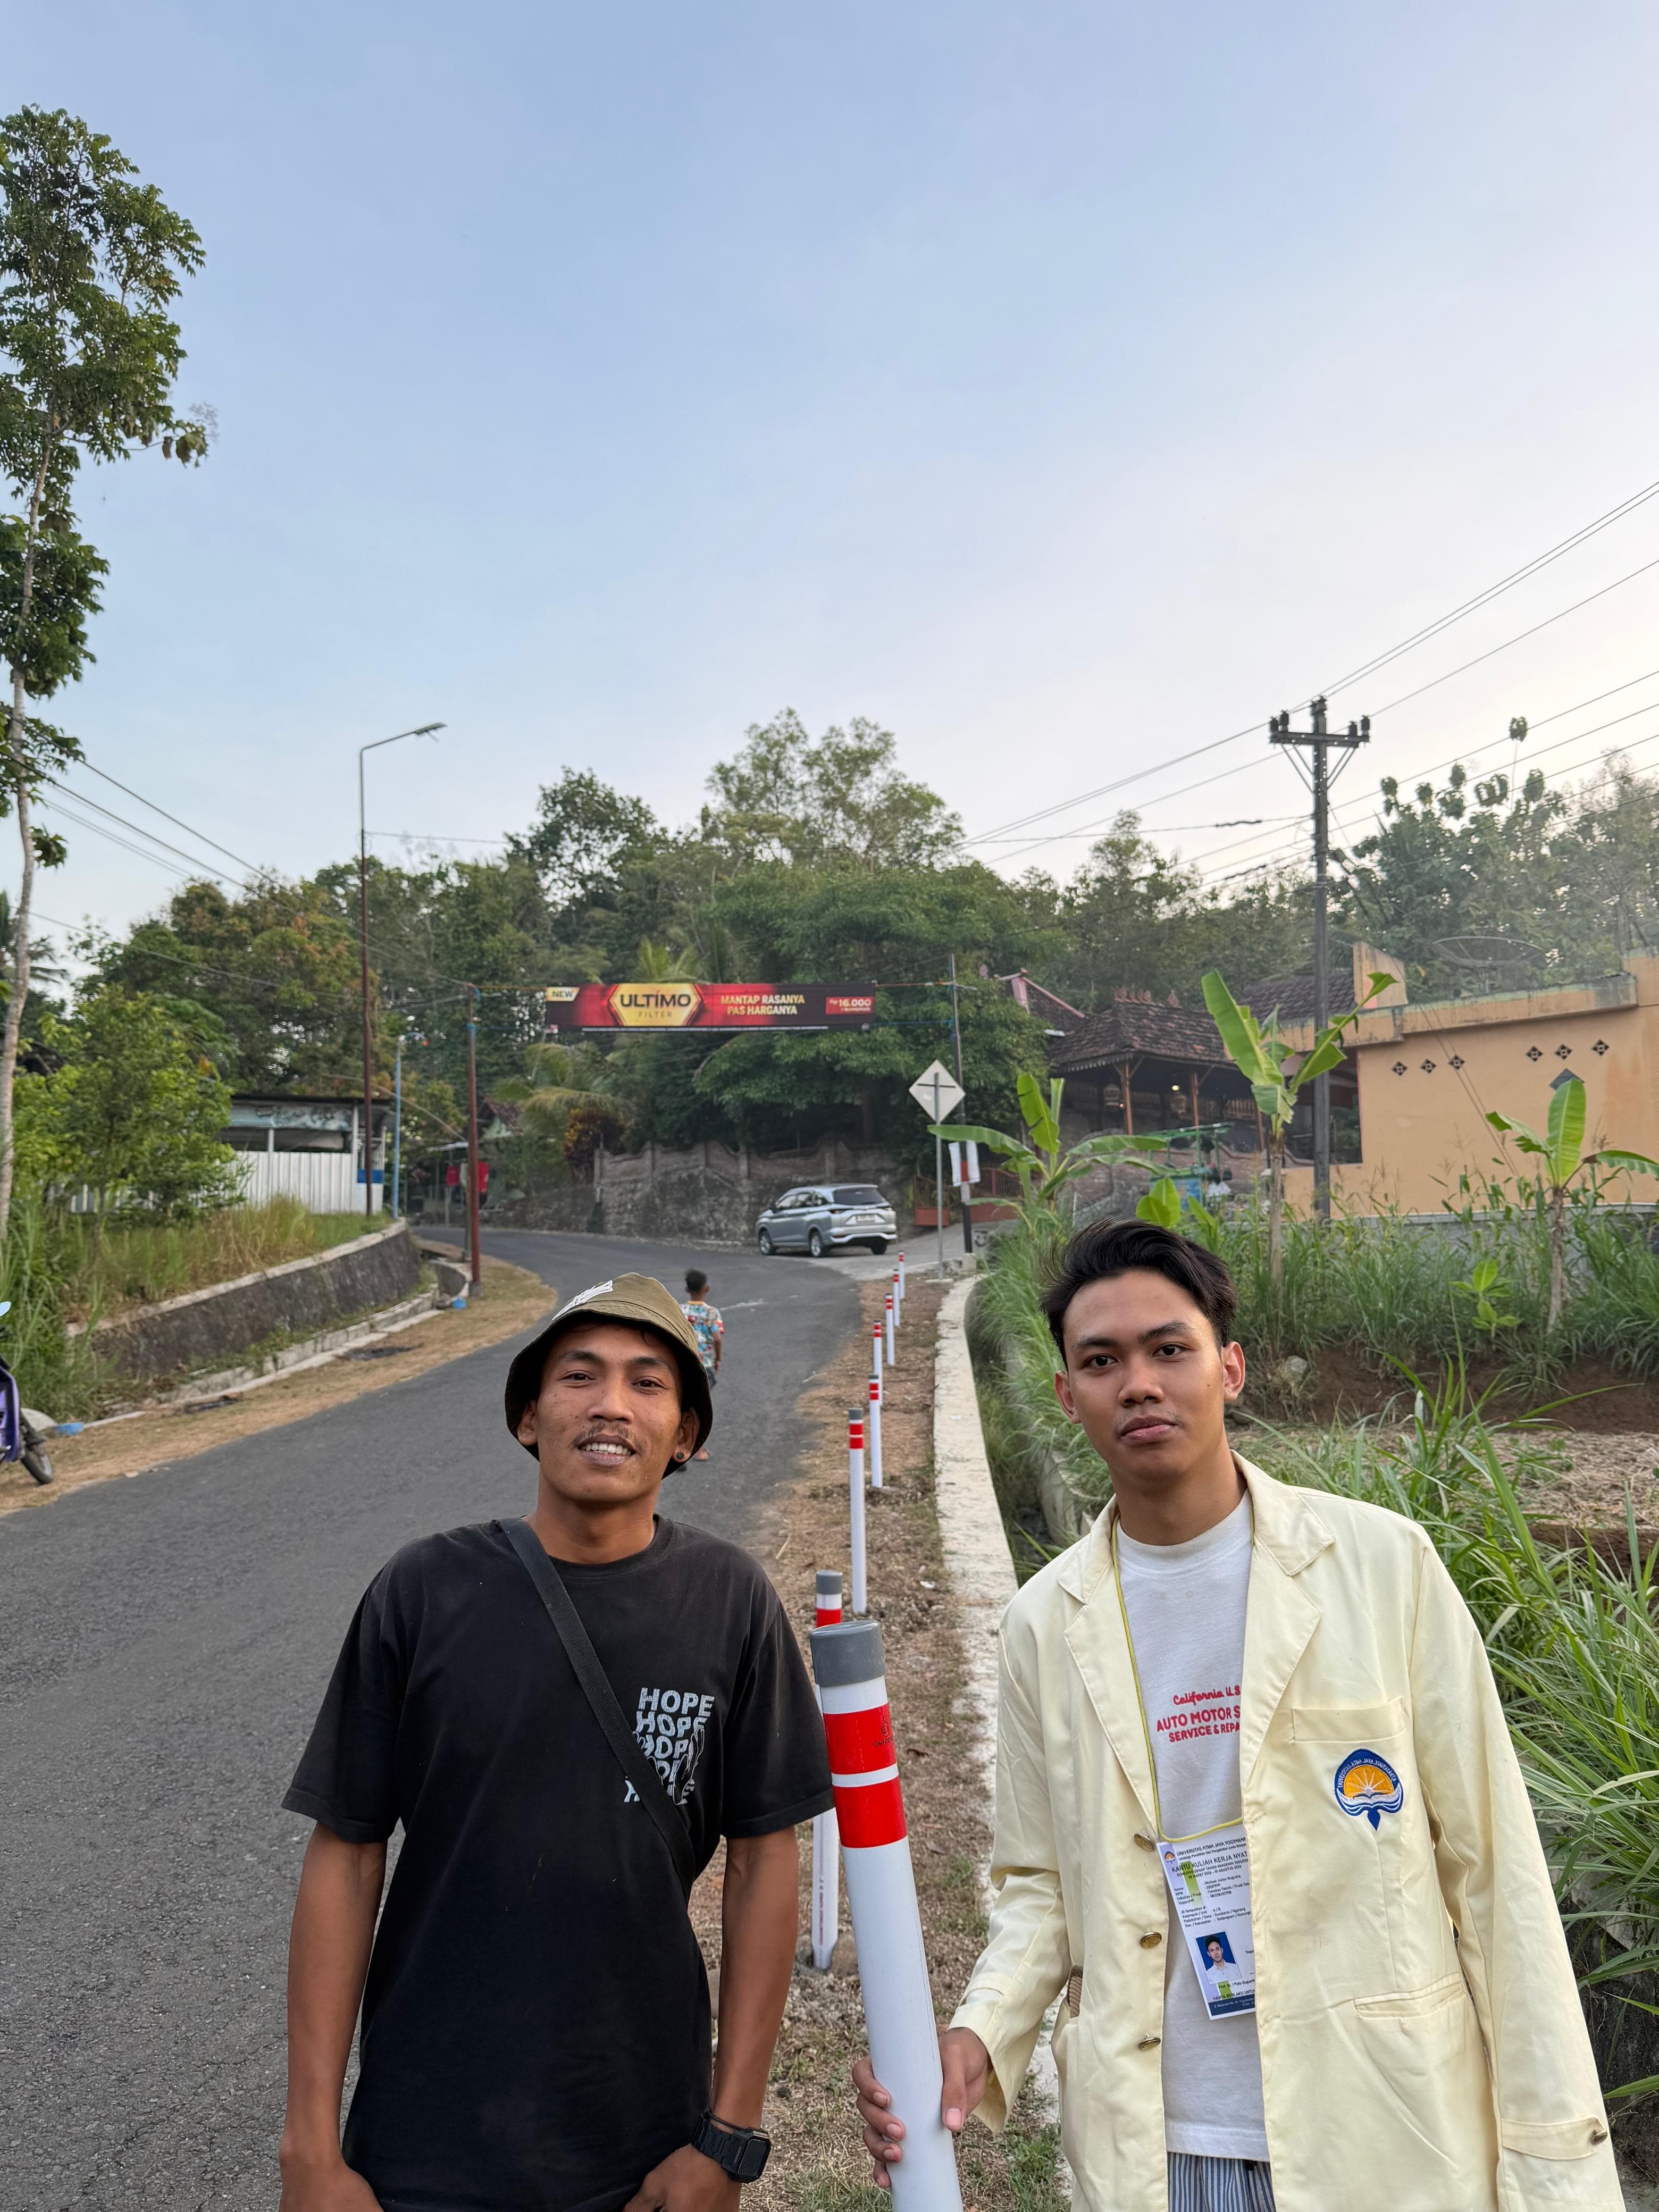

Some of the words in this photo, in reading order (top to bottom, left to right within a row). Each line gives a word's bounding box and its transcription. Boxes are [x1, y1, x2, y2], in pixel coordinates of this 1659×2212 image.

[721, 994, 760, 1004] MANTAP
[761, 994, 805, 1004] RASANYA
[727, 1006, 745, 1015] PAS
[747, 1005, 798, 1015] HARGANYA
[638, 1687, 715, 1717] HOPE
[1173, 1688, 1224, 1706] California
[1157, 1713, 1188, 1732] AUTO
[1190, 1707, 1232, 1724] MOTOR
[1168, 1725, 1212, 1742] SERVICE
[1213, 1724, 1220, 1735] &
[1176, 1847, 1203, 1856] UNIVERSITAS
[1171, 1863, 1191, 1873] KARTU
[1191, 1859, 1213, 1869] KULIAH
